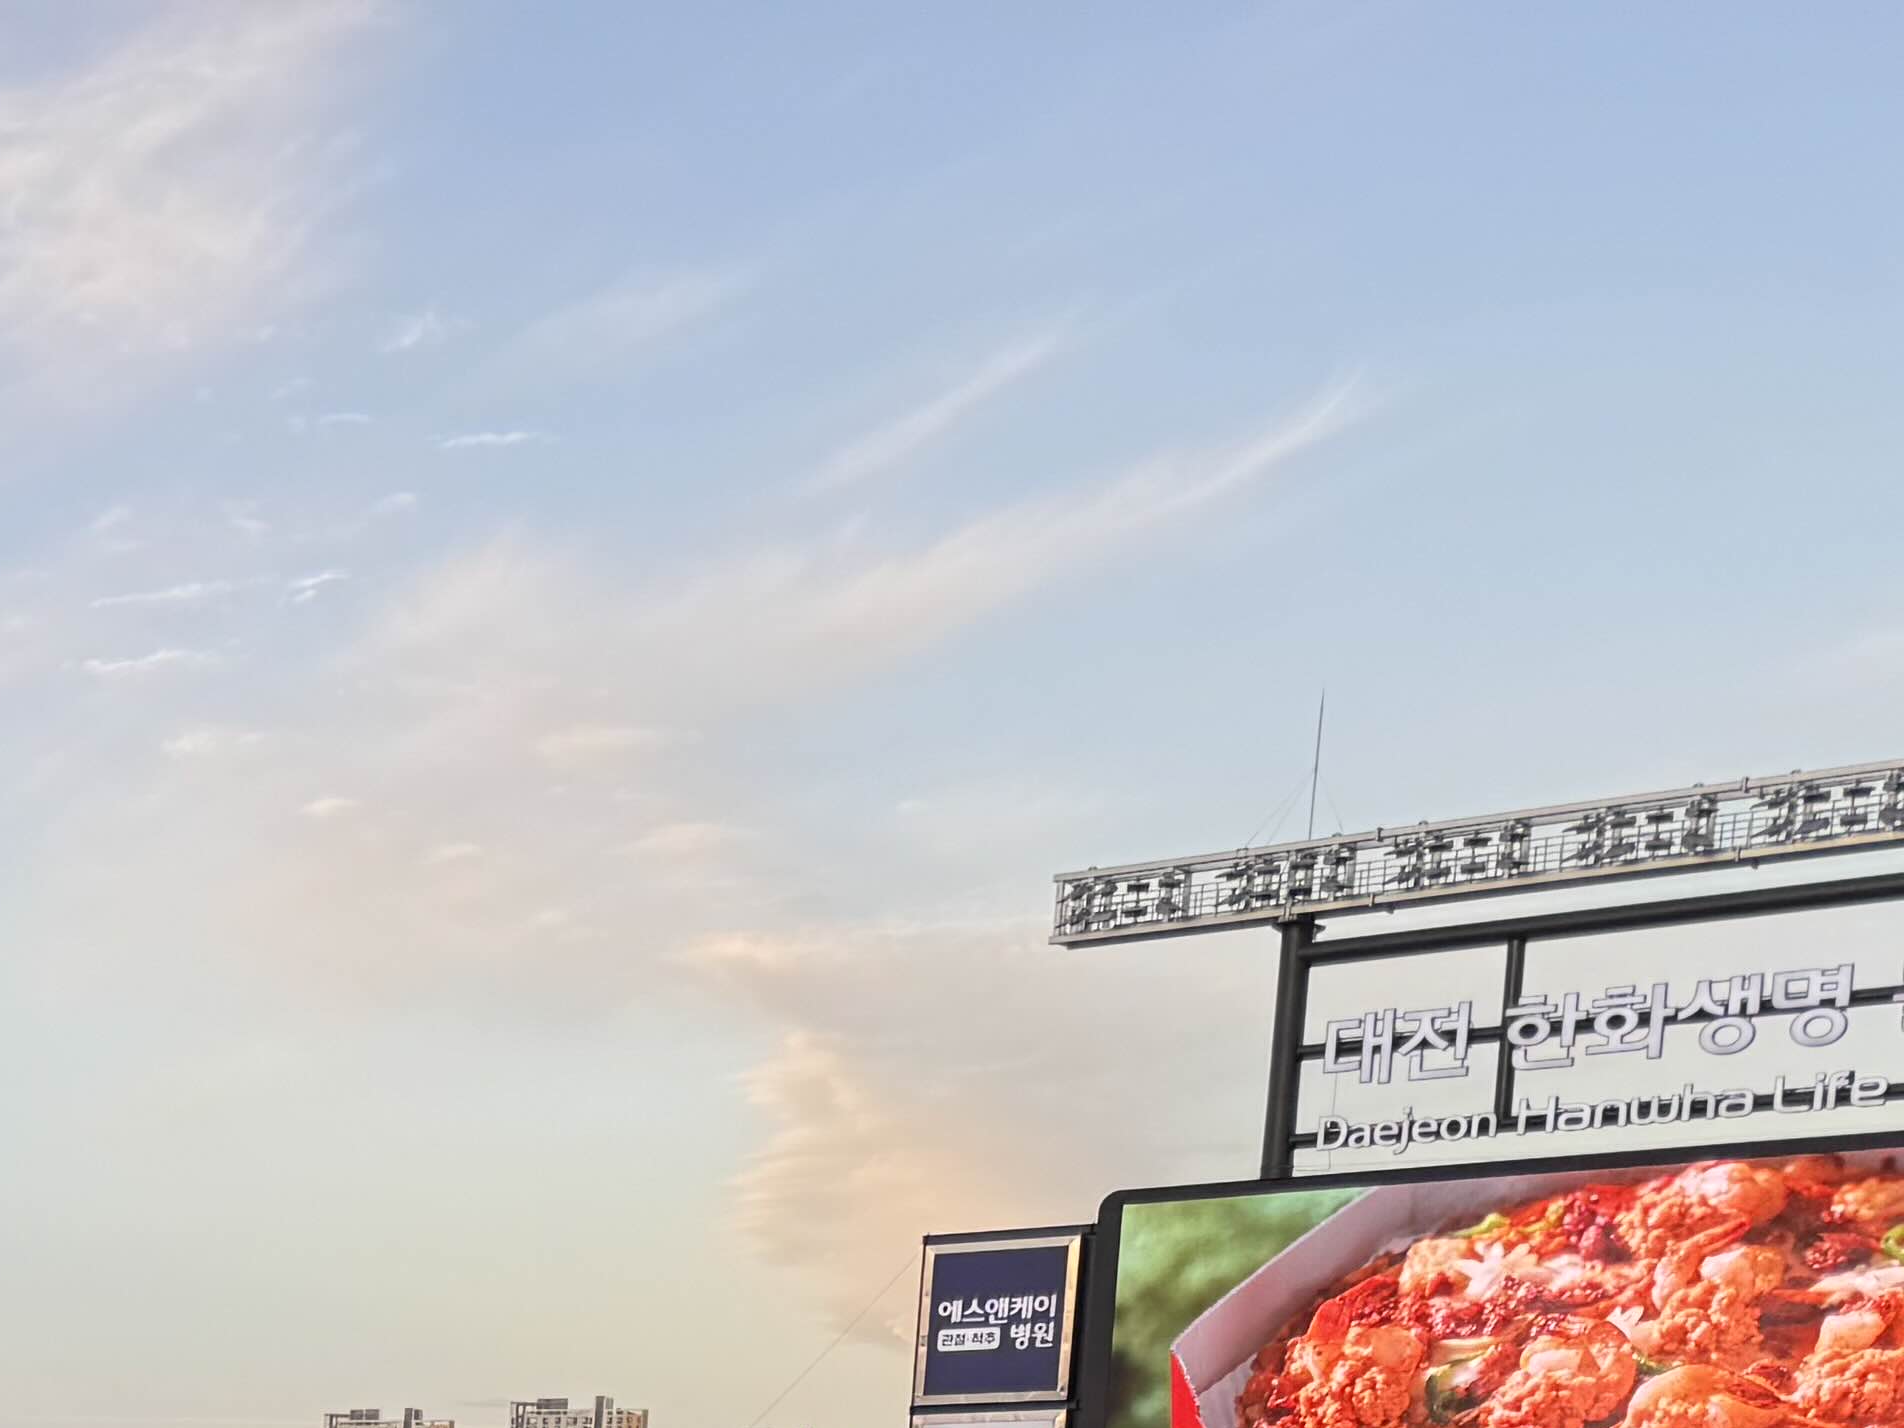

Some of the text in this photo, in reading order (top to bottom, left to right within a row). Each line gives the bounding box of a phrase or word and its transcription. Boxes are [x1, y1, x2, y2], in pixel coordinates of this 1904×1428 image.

[1322, 962, 1855, 1084] 대전 한화생명
[1316, 1071, 1889, 1154] Daejeon Hanwha Life
[938, 1294, 1057, 1324] 에스앤케이
[1010, 1322, 1054, 1350] 병원
